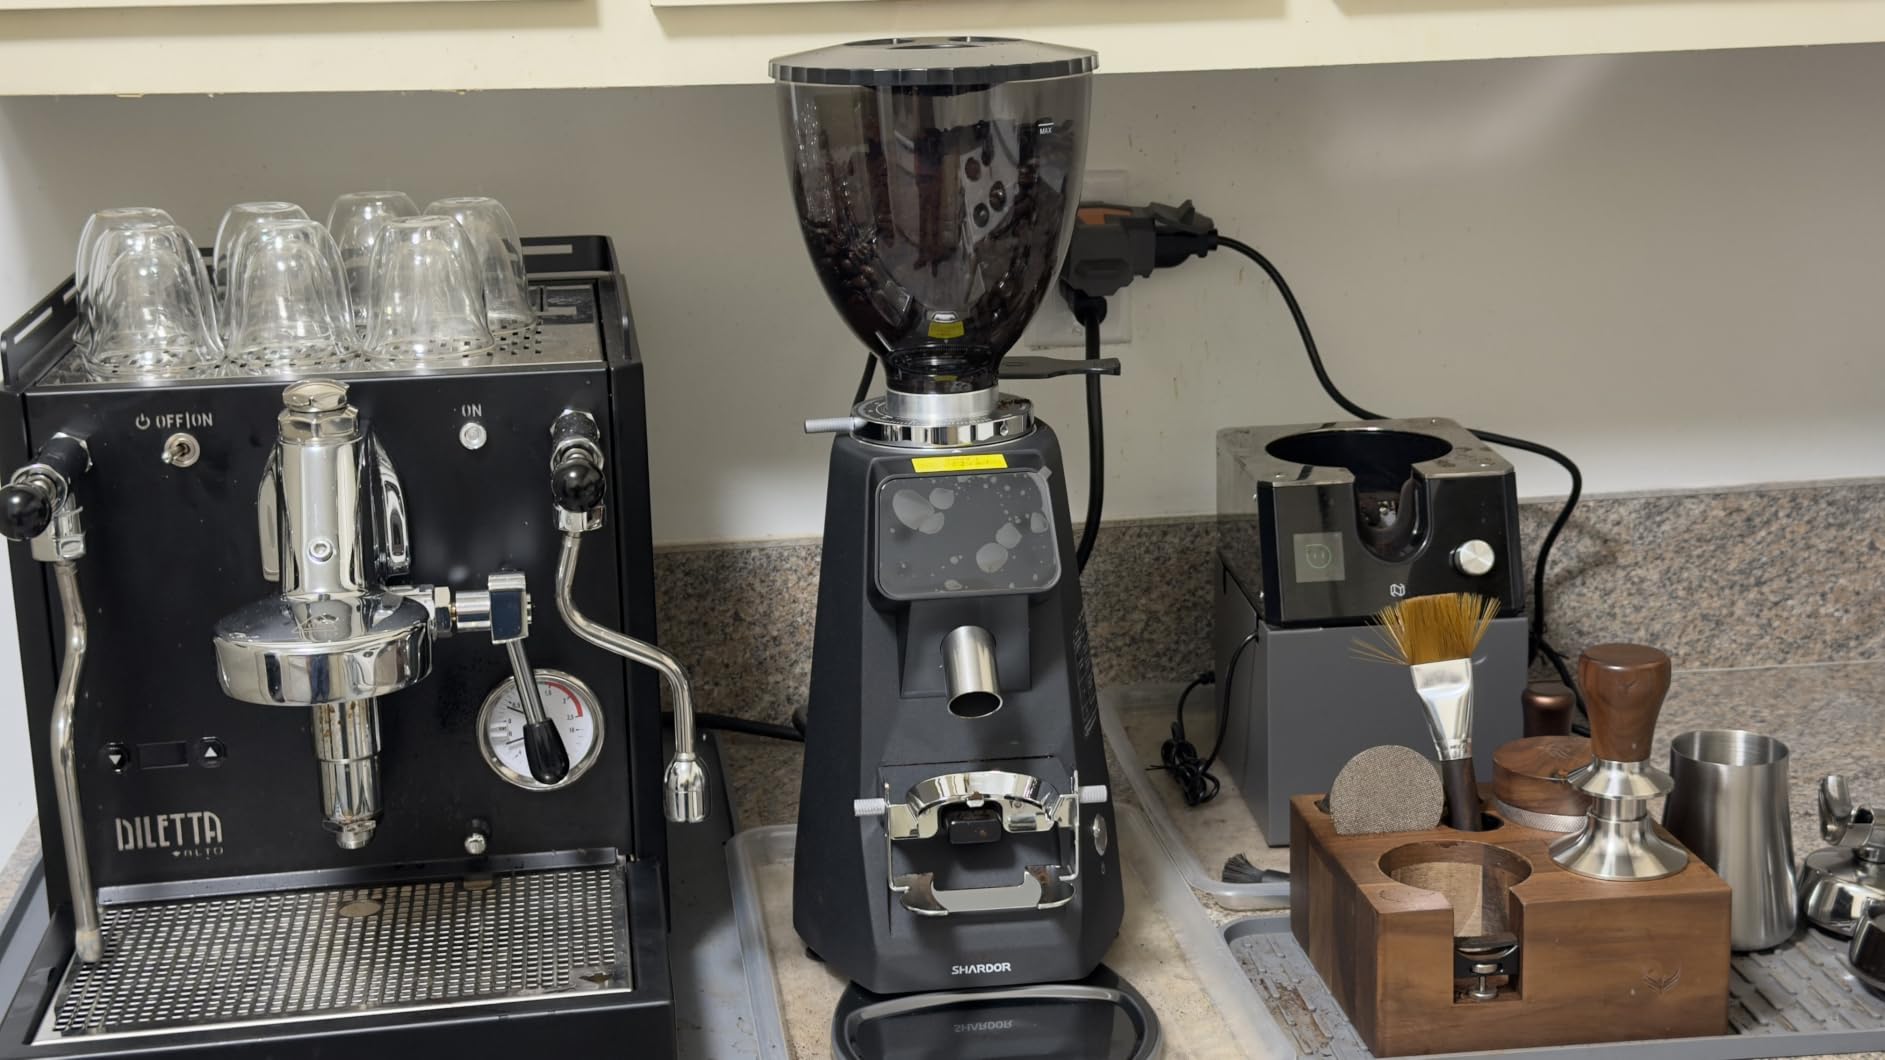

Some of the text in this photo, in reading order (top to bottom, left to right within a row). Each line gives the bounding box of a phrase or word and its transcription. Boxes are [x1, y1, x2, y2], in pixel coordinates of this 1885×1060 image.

[1039, 127, 1052, 135] MAX
[461, 403, 482, 417] ON
[115, 811, 223, 851] DILETTA
[951, 962, 1012, 975] SHARDOR
